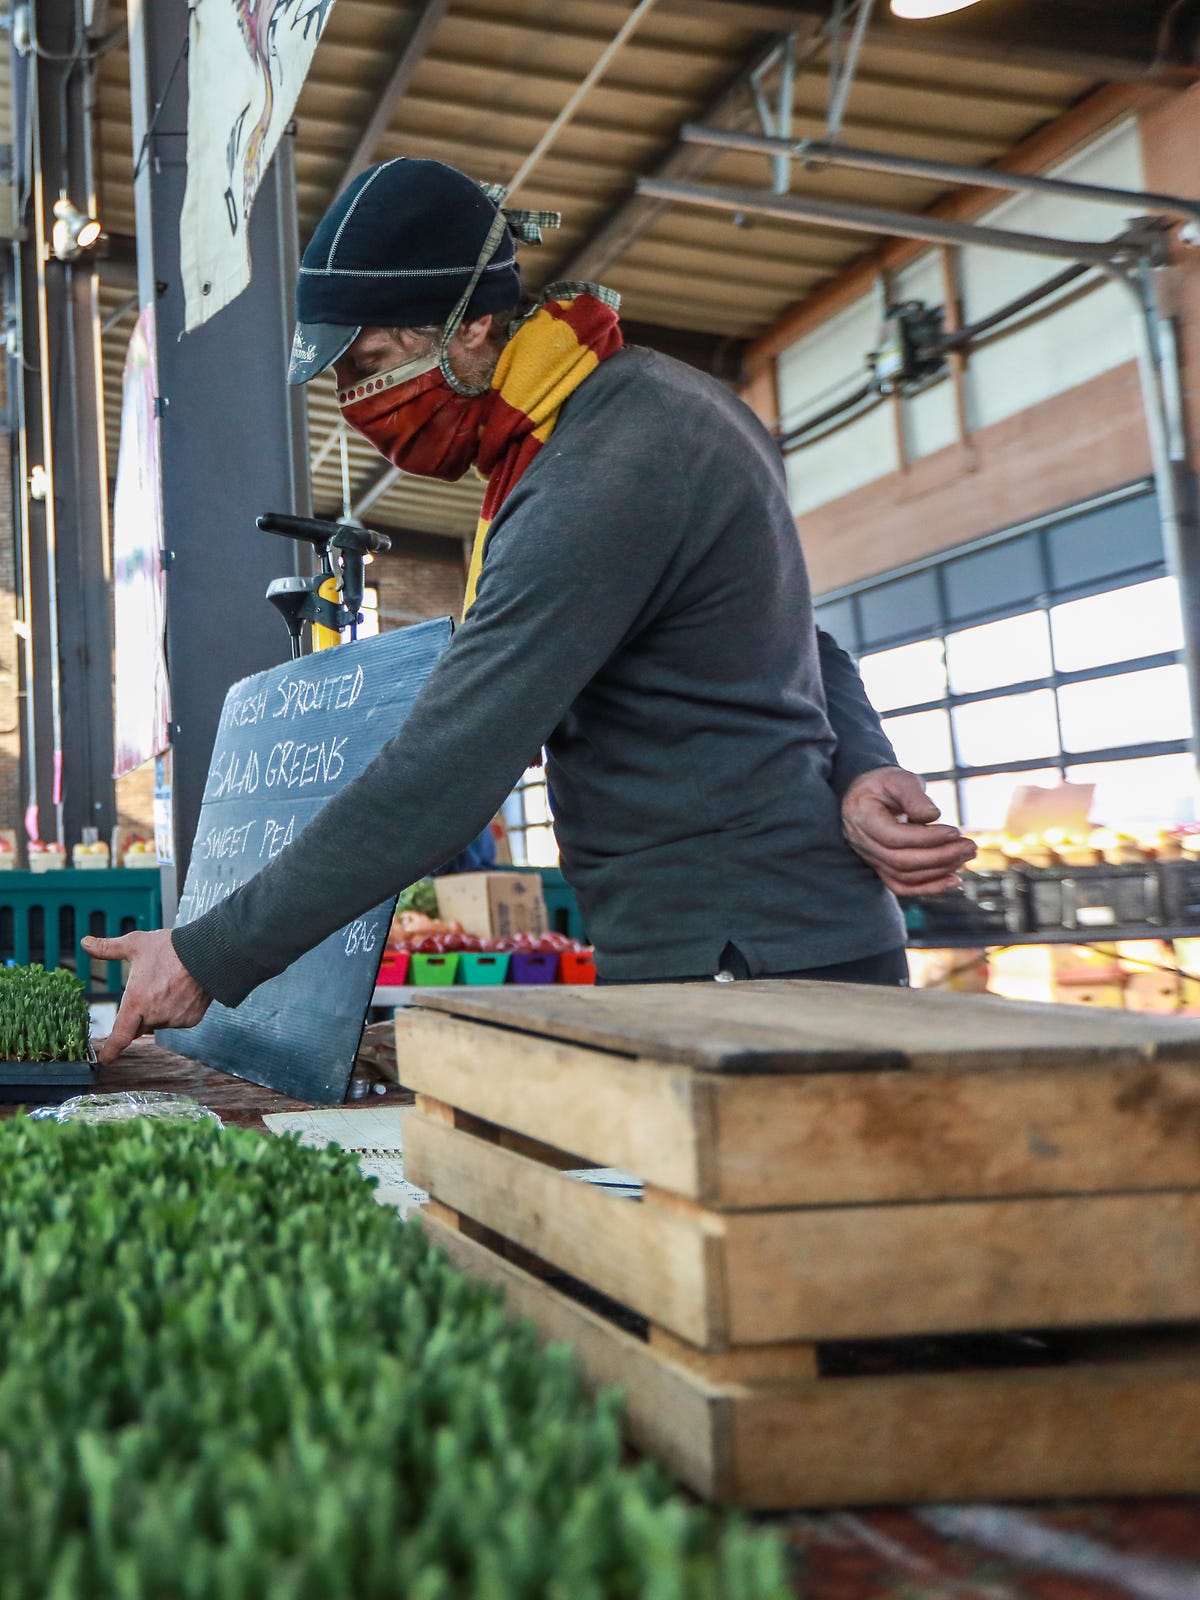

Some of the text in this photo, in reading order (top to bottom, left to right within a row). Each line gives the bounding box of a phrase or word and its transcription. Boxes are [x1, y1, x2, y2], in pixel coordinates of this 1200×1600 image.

[222, 663, 365, 731] FRESH SPROUTED
[210, 736, 350, 797] SALAD GREENS
[258, 814, 296, 859] PEA
